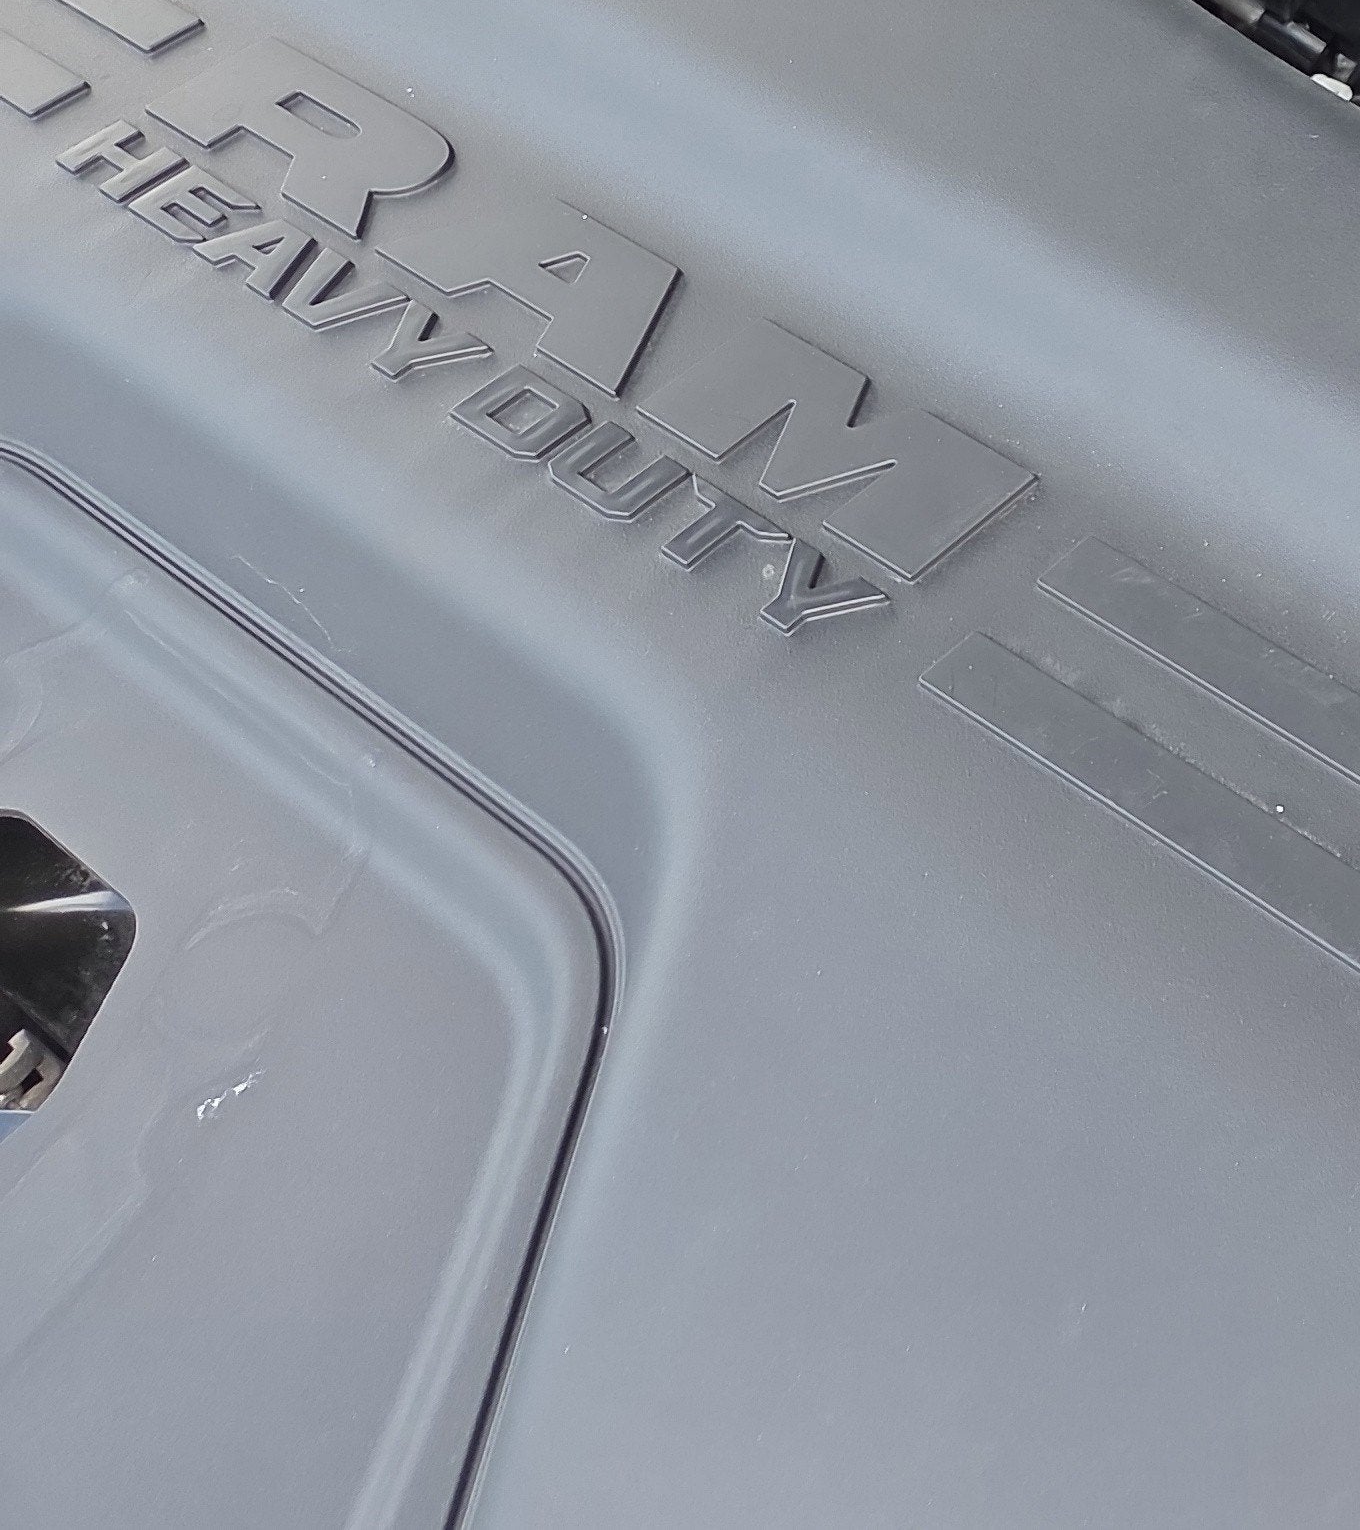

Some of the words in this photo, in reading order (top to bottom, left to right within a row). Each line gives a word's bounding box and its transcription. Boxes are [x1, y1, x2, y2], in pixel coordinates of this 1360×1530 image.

[56, 120, 494, 383] HEAVY
[448, 363, 892, 637] DUTY
[145, 36, 1040, 584] RAM
